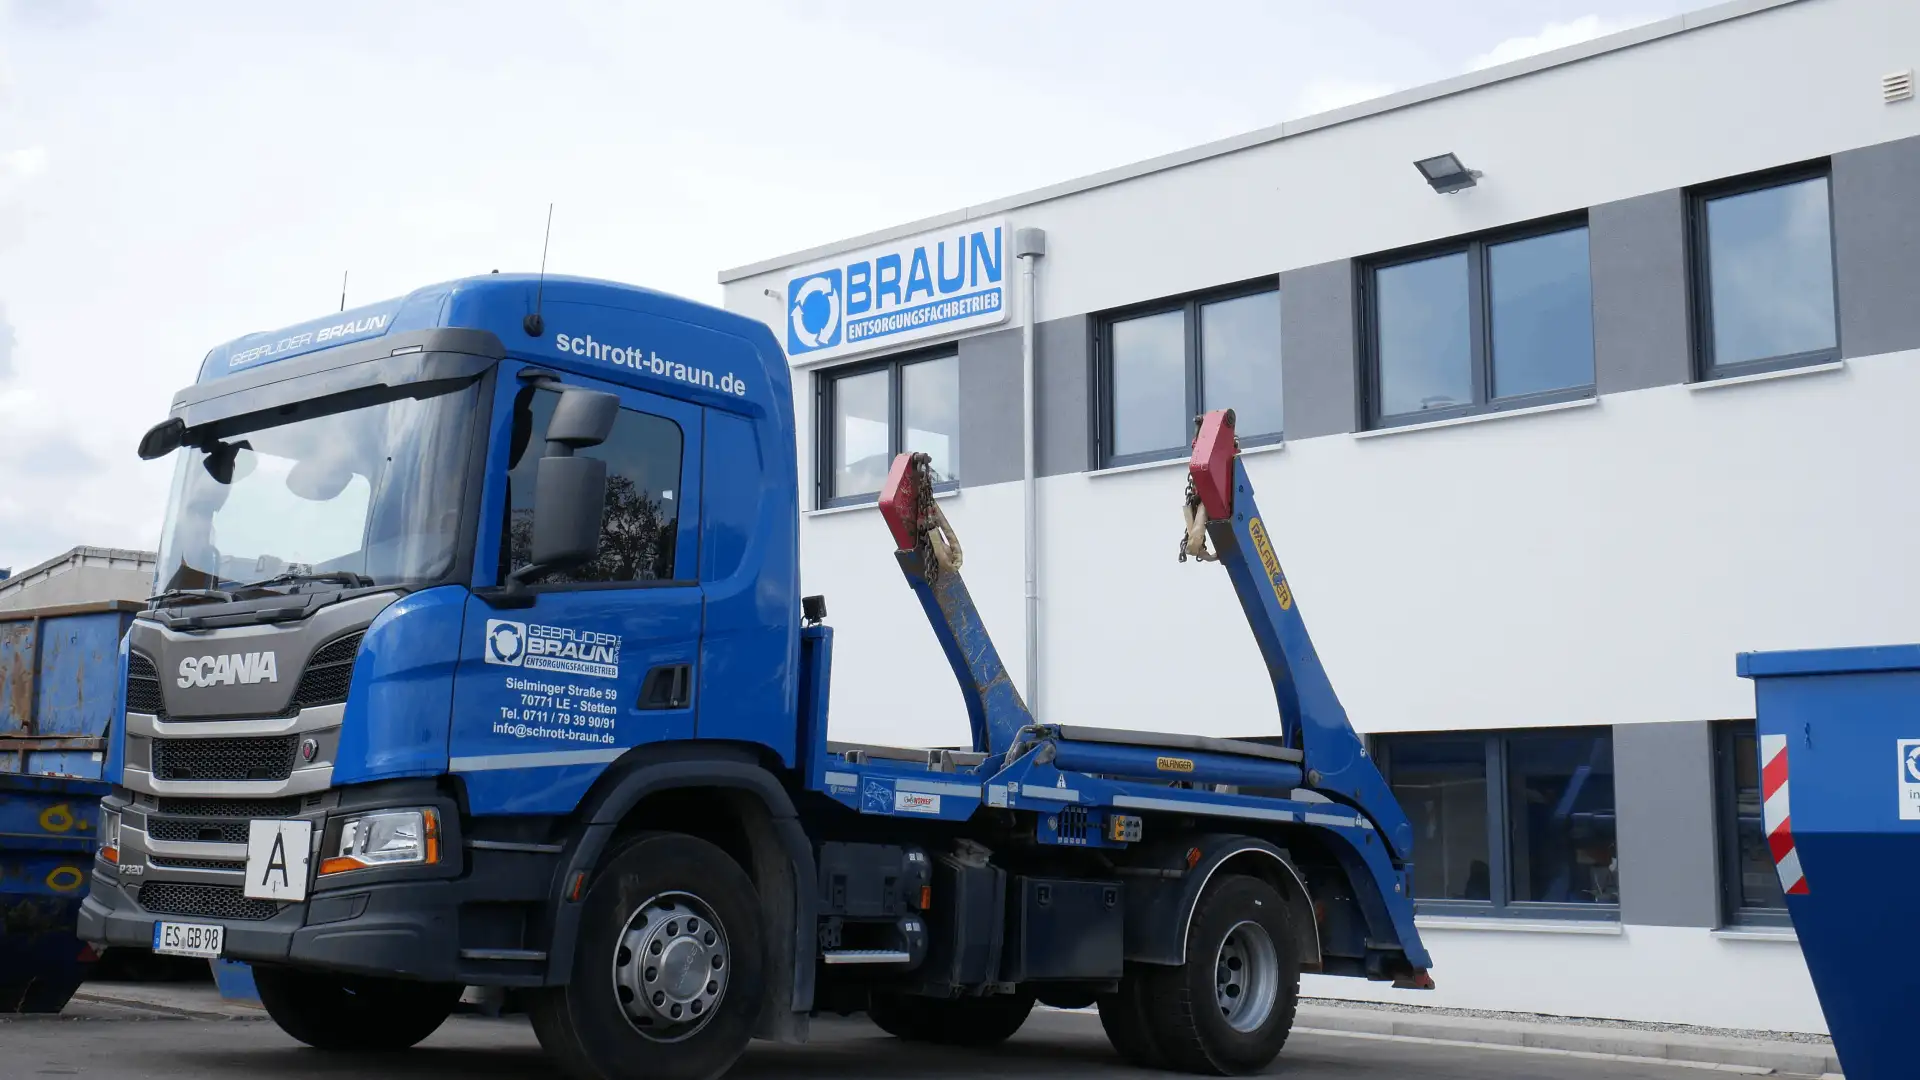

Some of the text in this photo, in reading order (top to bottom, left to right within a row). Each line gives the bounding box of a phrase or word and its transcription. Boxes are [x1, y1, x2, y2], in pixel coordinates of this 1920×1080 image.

[847, 227, 1002, 316] BRAUN
[848, 291, 999, 340] ENTSORGUNGSFACHBETRIEB
[316, 314, 387, 343] BRAUN
[556, 333, 746, 396] schrott-braun.de
[528, 623, 617, 646] GEBRÜDER
[527, 636, 614, 664] BRAUN
[177, 652, 278, 689] SCANIA
[526, 657, 616, 676] ENTSORGUNGSFACHBETRIEB
[506, 677, 617, 700] Sielminger Straße 59
[521, 694, 552, 707] 70771
[556, 698, 571, 709] LE
[580, 700, 617, 714] Stetten
[501, 707, 615, 730] Tel. 0711 / 79 39 90/91
[493, 722, 615, 744] info@schrott-braun.de
[1158, 758, 1192, 770] PALFINGER
[119, 864, 144, 876] P320
[262, 832, 289, 888] A
[165, 925, 181, 947] ES
[187, 927, 202, 948] GB
[204, 928, 219, 950] 98
